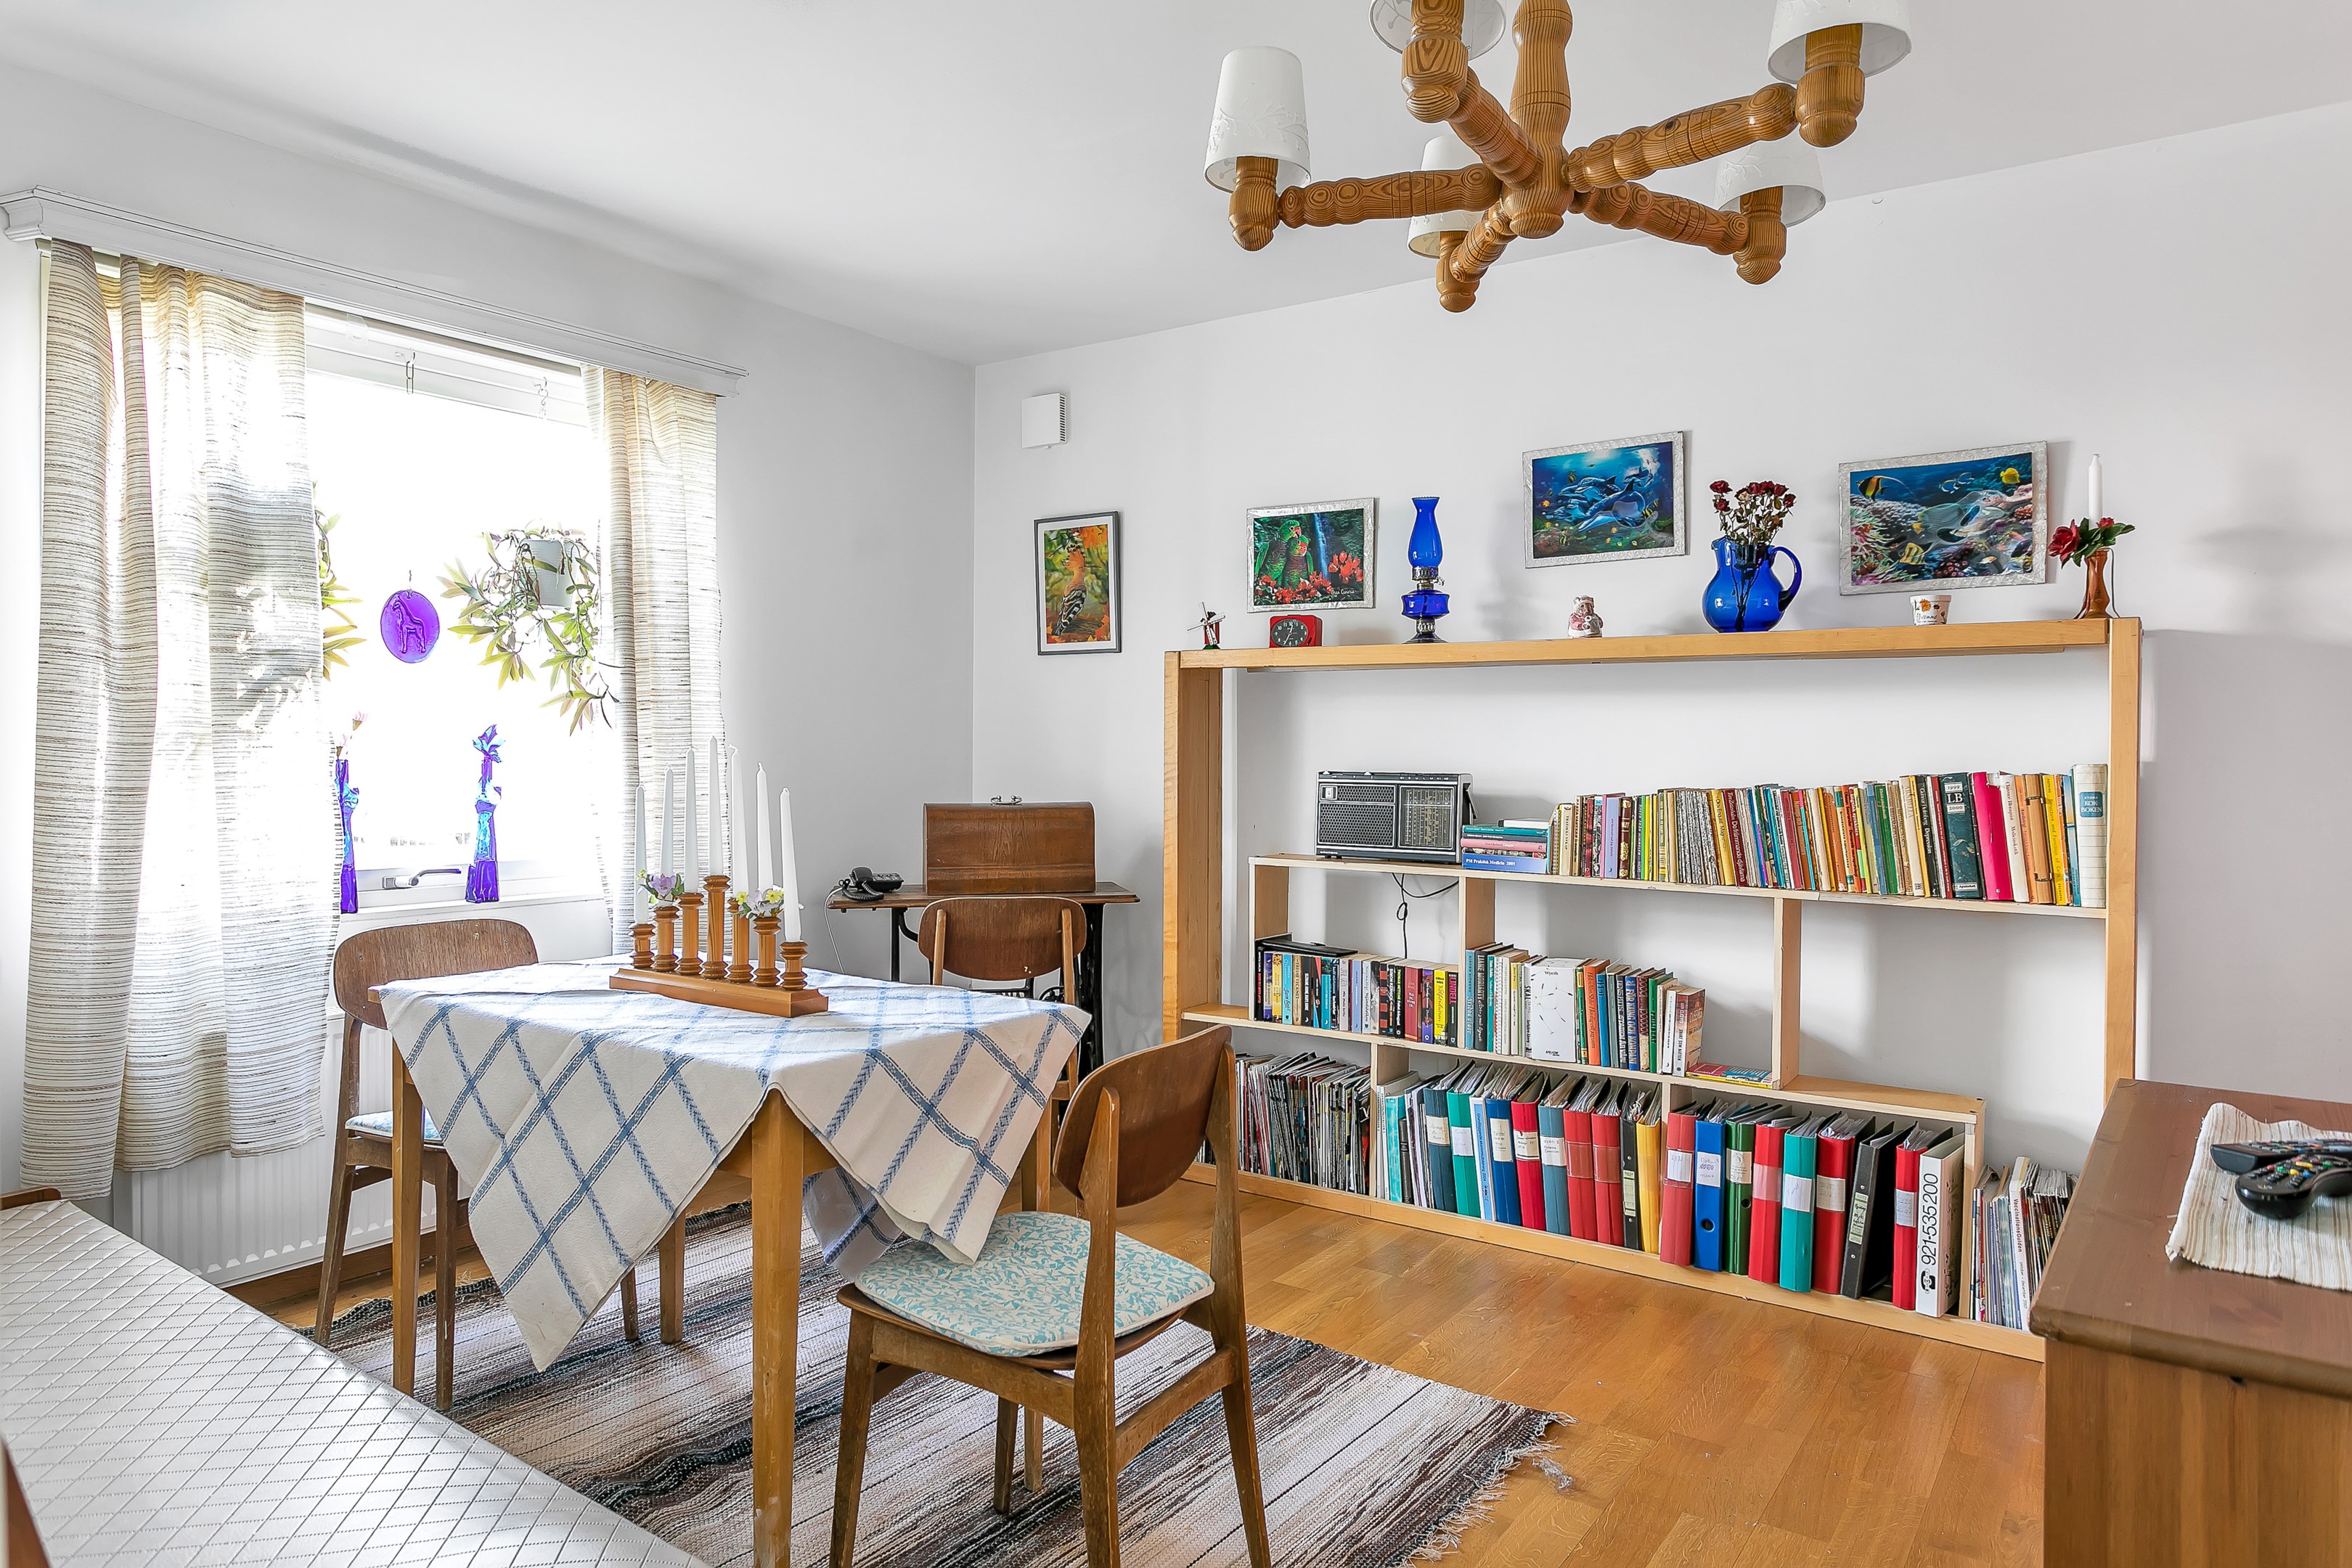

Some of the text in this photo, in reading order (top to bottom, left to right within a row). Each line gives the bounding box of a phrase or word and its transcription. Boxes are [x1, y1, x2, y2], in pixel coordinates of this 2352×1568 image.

[1946, 793, 1963, 804] LB
[1920, 804, 1929, 825] Holmberg
[1732, 829, 1741, 859] främmande
[1923, 828, 1932, 854] Depression
[1736, 859, 1745, 882] djävlarna
[1448, 976, 1457, 1005] LINDELL
[1625, 987, 1637, 1064] FÖR KUNG OCH KOMPANI
[2012, 1199, 2022, 1253] VaccinationsGuiden
